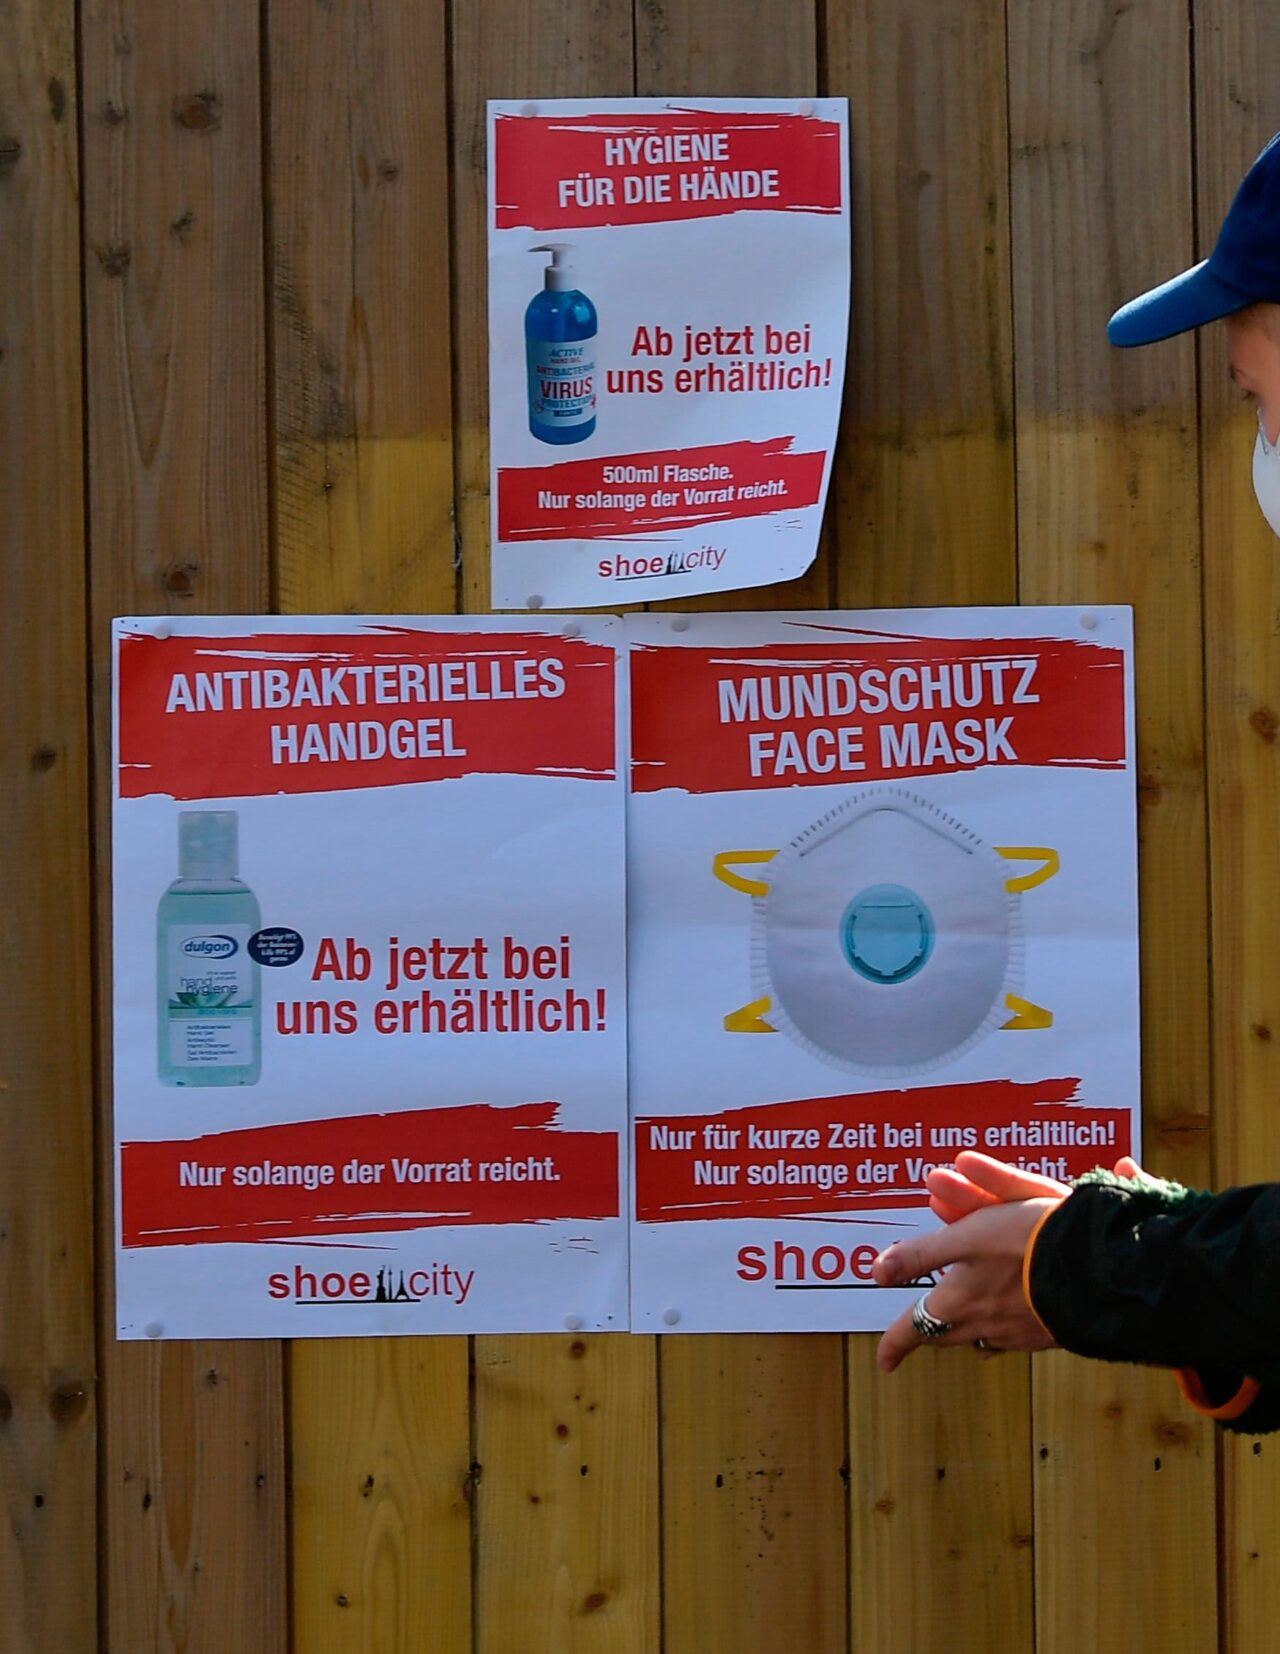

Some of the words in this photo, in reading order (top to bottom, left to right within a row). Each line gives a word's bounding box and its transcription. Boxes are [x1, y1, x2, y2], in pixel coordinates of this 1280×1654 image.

[604, 133, 730, 166] HYGIENE
[558, 173, 615, 208] FÜR
[623, 174, 671, 204] DIE
[680, 167, 780, 201] HÄNDE
[631, 326, 673, 356] Ab
[683, 325, 754, 362] jetzt
[765, 324, 811, 354] bei
[541, 377, 592, 399] VIRUS
[606, 368, 664, 393] uns
[674, 358, 832, 393] erhältlich!
[602, 466, 659, 484] 500ml
[663, 464, 734, 483] Flasche.
[538, 491, 571, 509] Nur
[575, 491, 646, 512] solange
[651, 490, 680, 508] der
[683, 485, 735, 506] Vorrat
[737, 479, 788, 500] reicht.
[165, 657, 566, 713] ANTIBAKTERIELLES
[718, 659, 1040, 724] MUNDSCHUTZ
[270, 718, 467, 765] HANDGEL
[748, 726, 866, 777] FACE
[879, 716, 1019, 769] MASK
[184, 941, 230, 954] dulgon
[311, 937, 371, 981] Ab
[386, 936, 489, 991] jetzt
[503, 936, 570, 980] bei
[276, 1000, 358, 1035] uns
[374, 988, 606, 1034] erhältlich!
[650, 1125, 696, 1150] Nur
[703, 1124, 741, 1150] für
[748, 1124, 821, 1149] kurze
[827, 1123, 877, 1149] Zeit
[884, 1122, 923, 1148] bei
[930, 1126, 977, 1148] uns
[984, 1120, 1116, 1147] erhältlich!
[179, 1161, 226, 1187] Nur
[233, 1160, 335, 1190] solange
[342, 1159, 385, 1185] der
[391, 1157, 472, 1185] Vorrat
[478, 1156, 561, 1183] reicht.
[694, 1160, 741, 1186] Nur
[747, 1159, 849, 1190] solange
[856, 1158, 899, 1184] der
[736, 1241, 880, 1281] shoe
